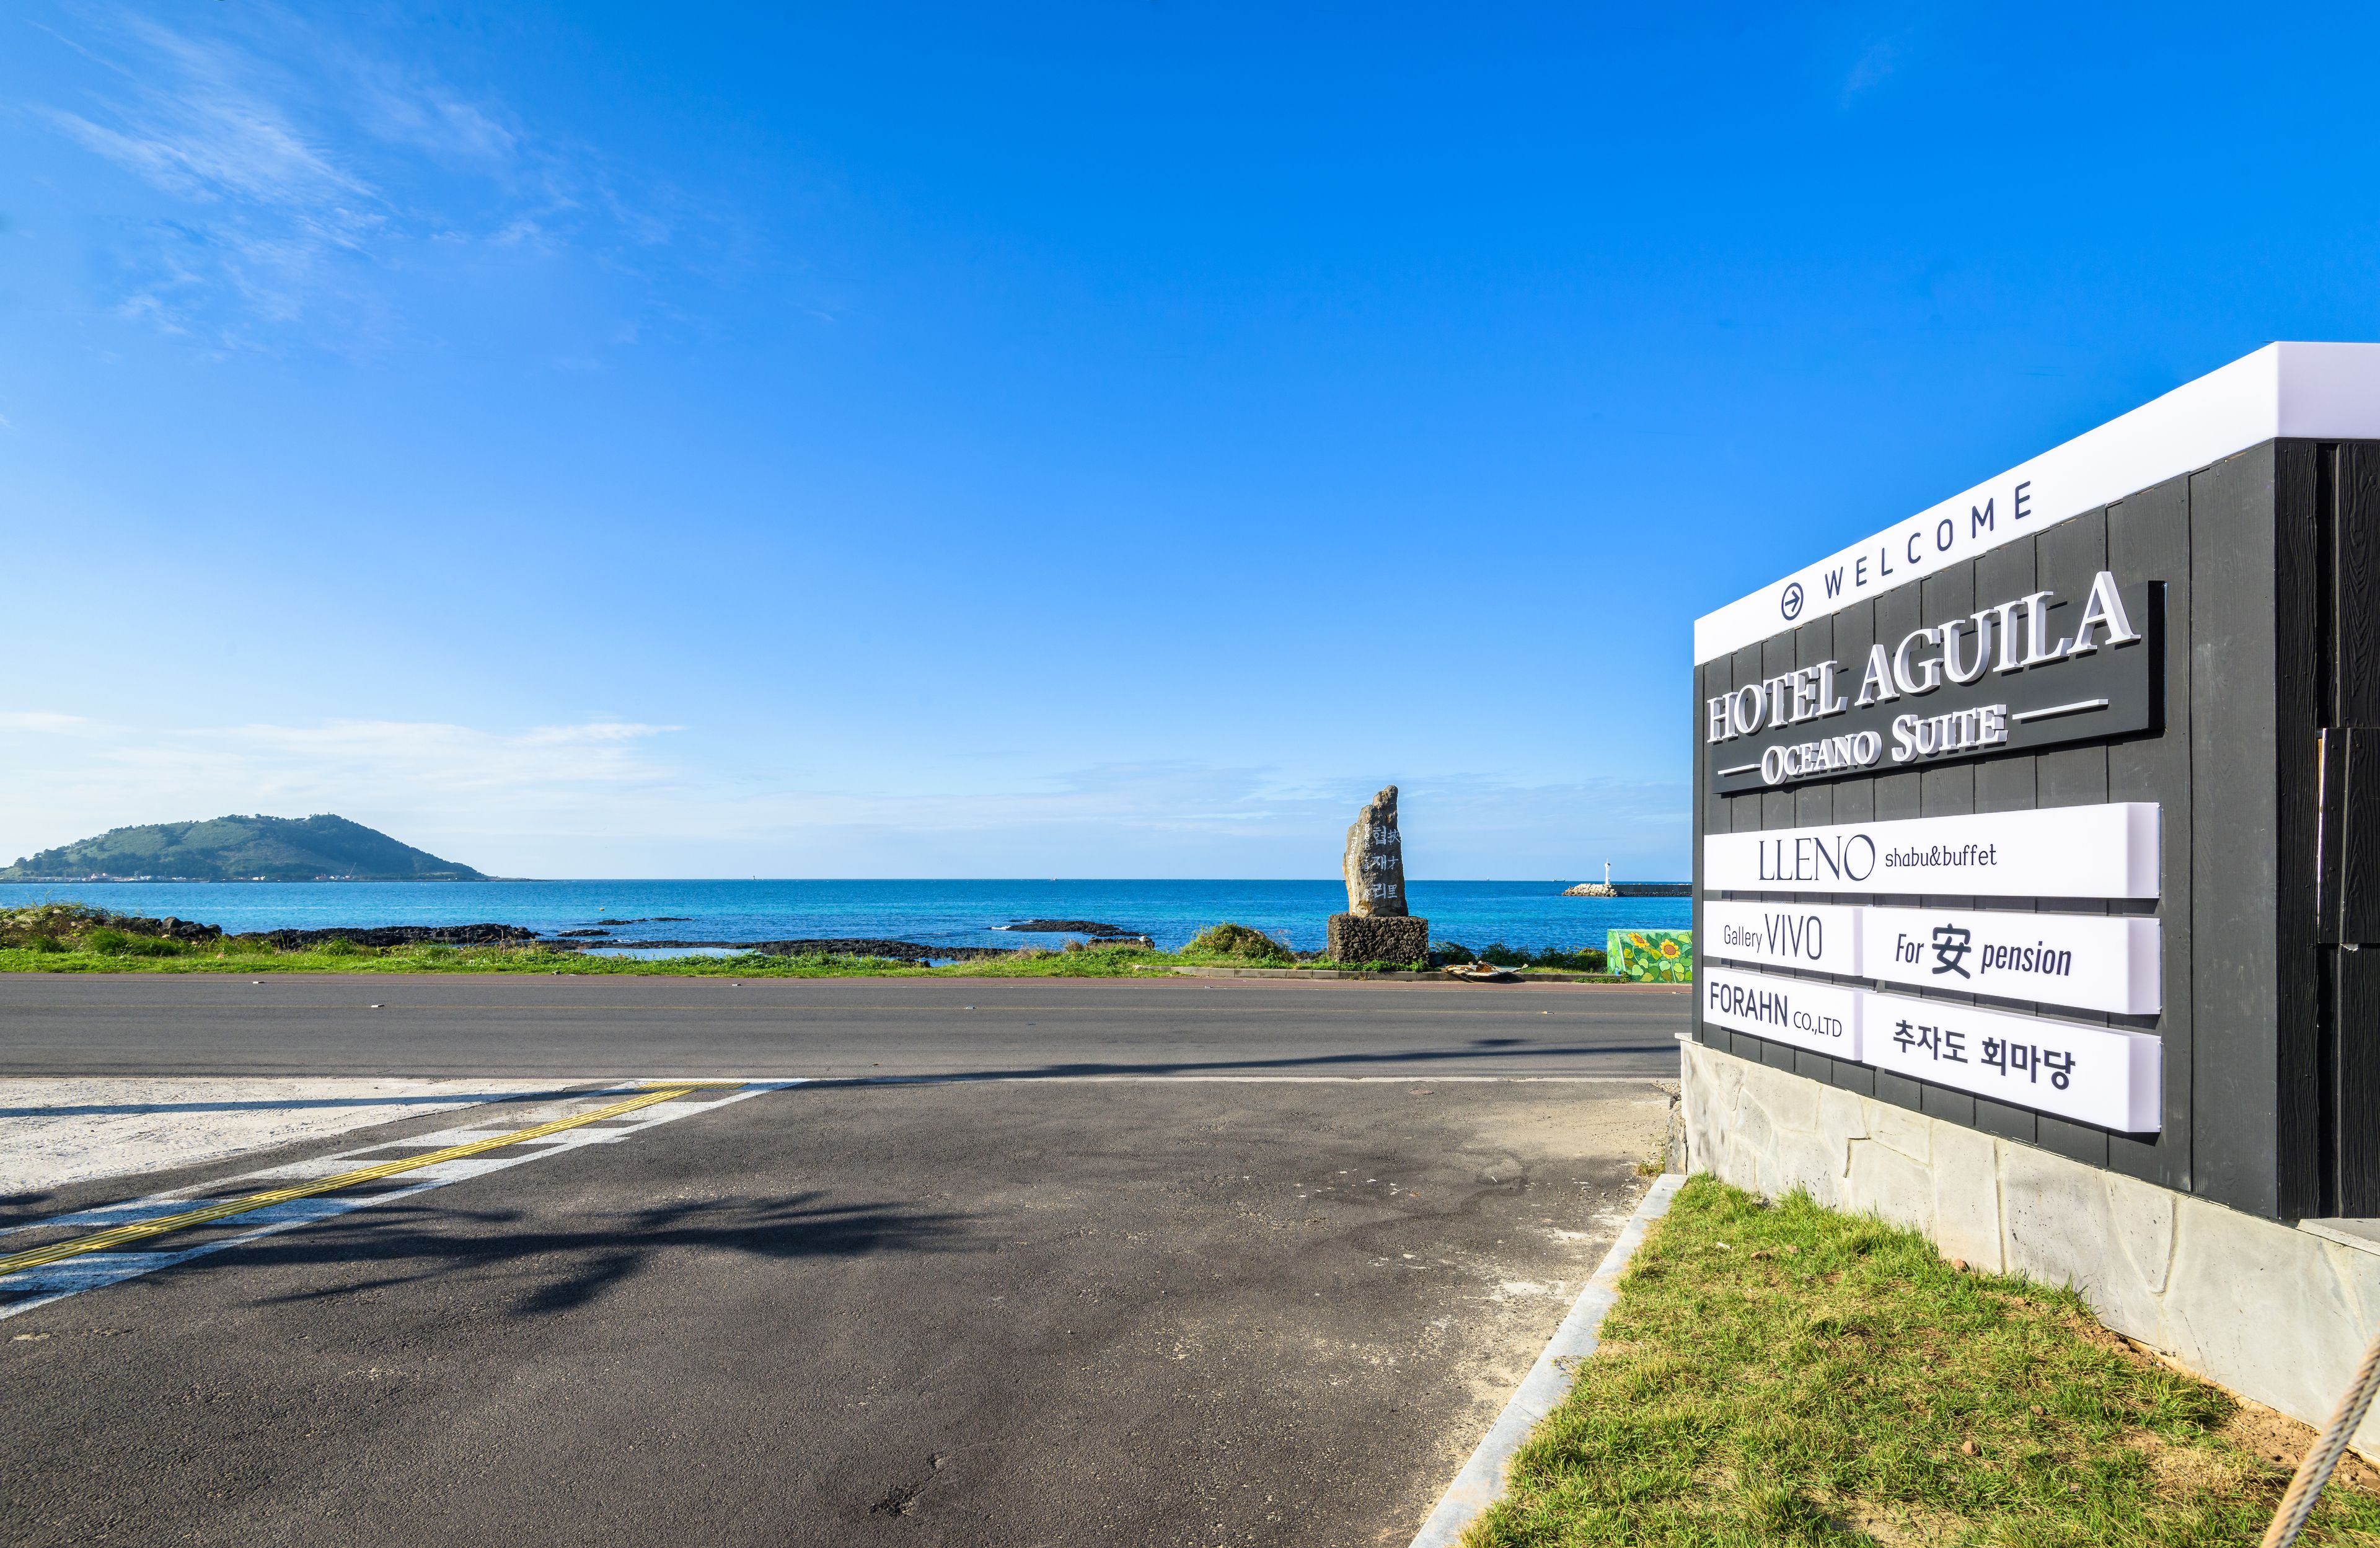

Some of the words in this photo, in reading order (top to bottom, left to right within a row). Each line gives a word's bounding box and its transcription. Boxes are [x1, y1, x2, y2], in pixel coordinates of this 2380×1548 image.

[1825, 481, 2031, 599] WELCOME
[1707, 660, 1848, 743] HOTEL
[1855, 571, 2141, 705] AGUILA
[1761, 731, 1882, 785] OCEANO
[1892, 704, 2008, 762] SUITE
[1758, 834, 1875, 881] LLENO
[1885, 843, 1998, 868] shabu&buffet
[1724, 925, 1762, 953] Gallery
[1765, 913, 1822, 961] VIVO
[1895, 933, 1924, 964] For
[1931, 923, 1972, 980] 安
[1980, 941, 2071, 976] pension
[1711, 981, 1787, 1027] FORAHN
[1893, 1019, 1968, 1064] 추자도
[1981, 1037, 2076, 1090] 회마당
